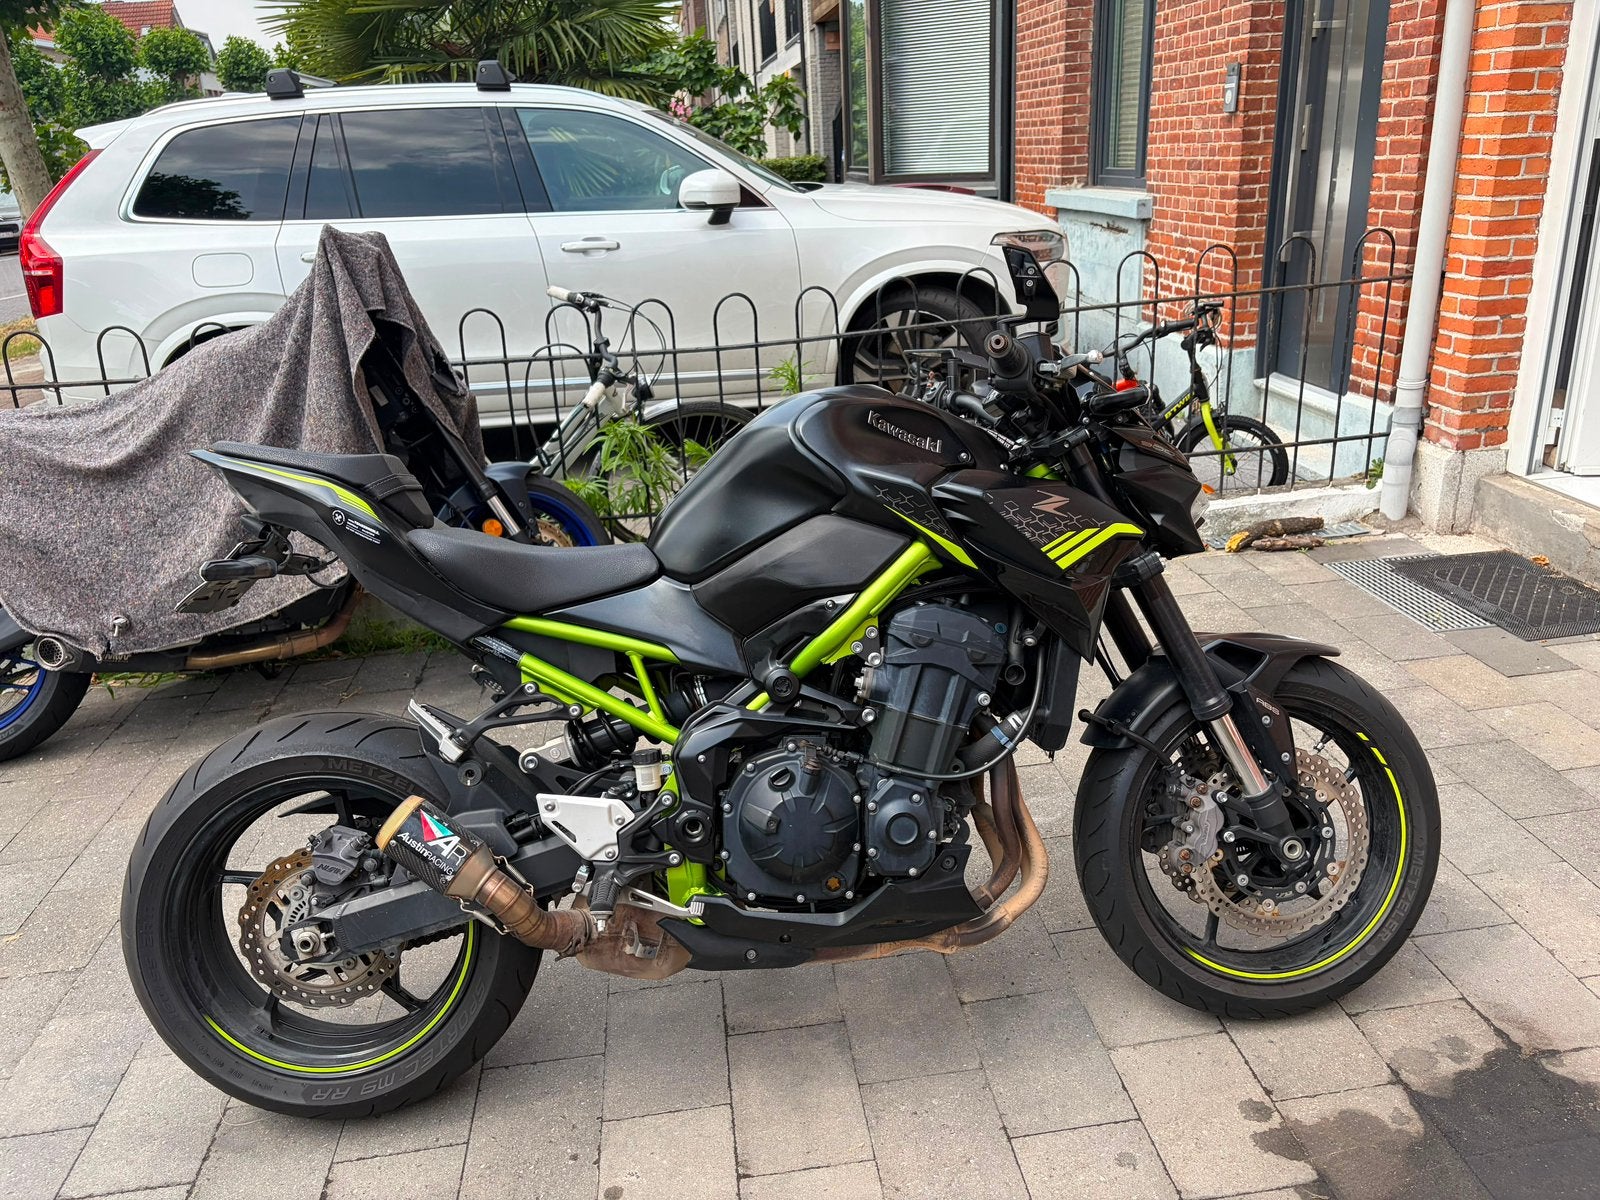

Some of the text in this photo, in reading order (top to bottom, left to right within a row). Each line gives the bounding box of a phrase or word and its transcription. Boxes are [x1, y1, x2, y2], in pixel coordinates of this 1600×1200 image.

[867, 409, 943, 454] Kawasaki
[1255, 697, 1280, 716] ABS
[1377, 848, 1425, 941] METZELER
[399, 981, 487, 1083] SPORTEC
[311, 1087, 352, 1101] RR
